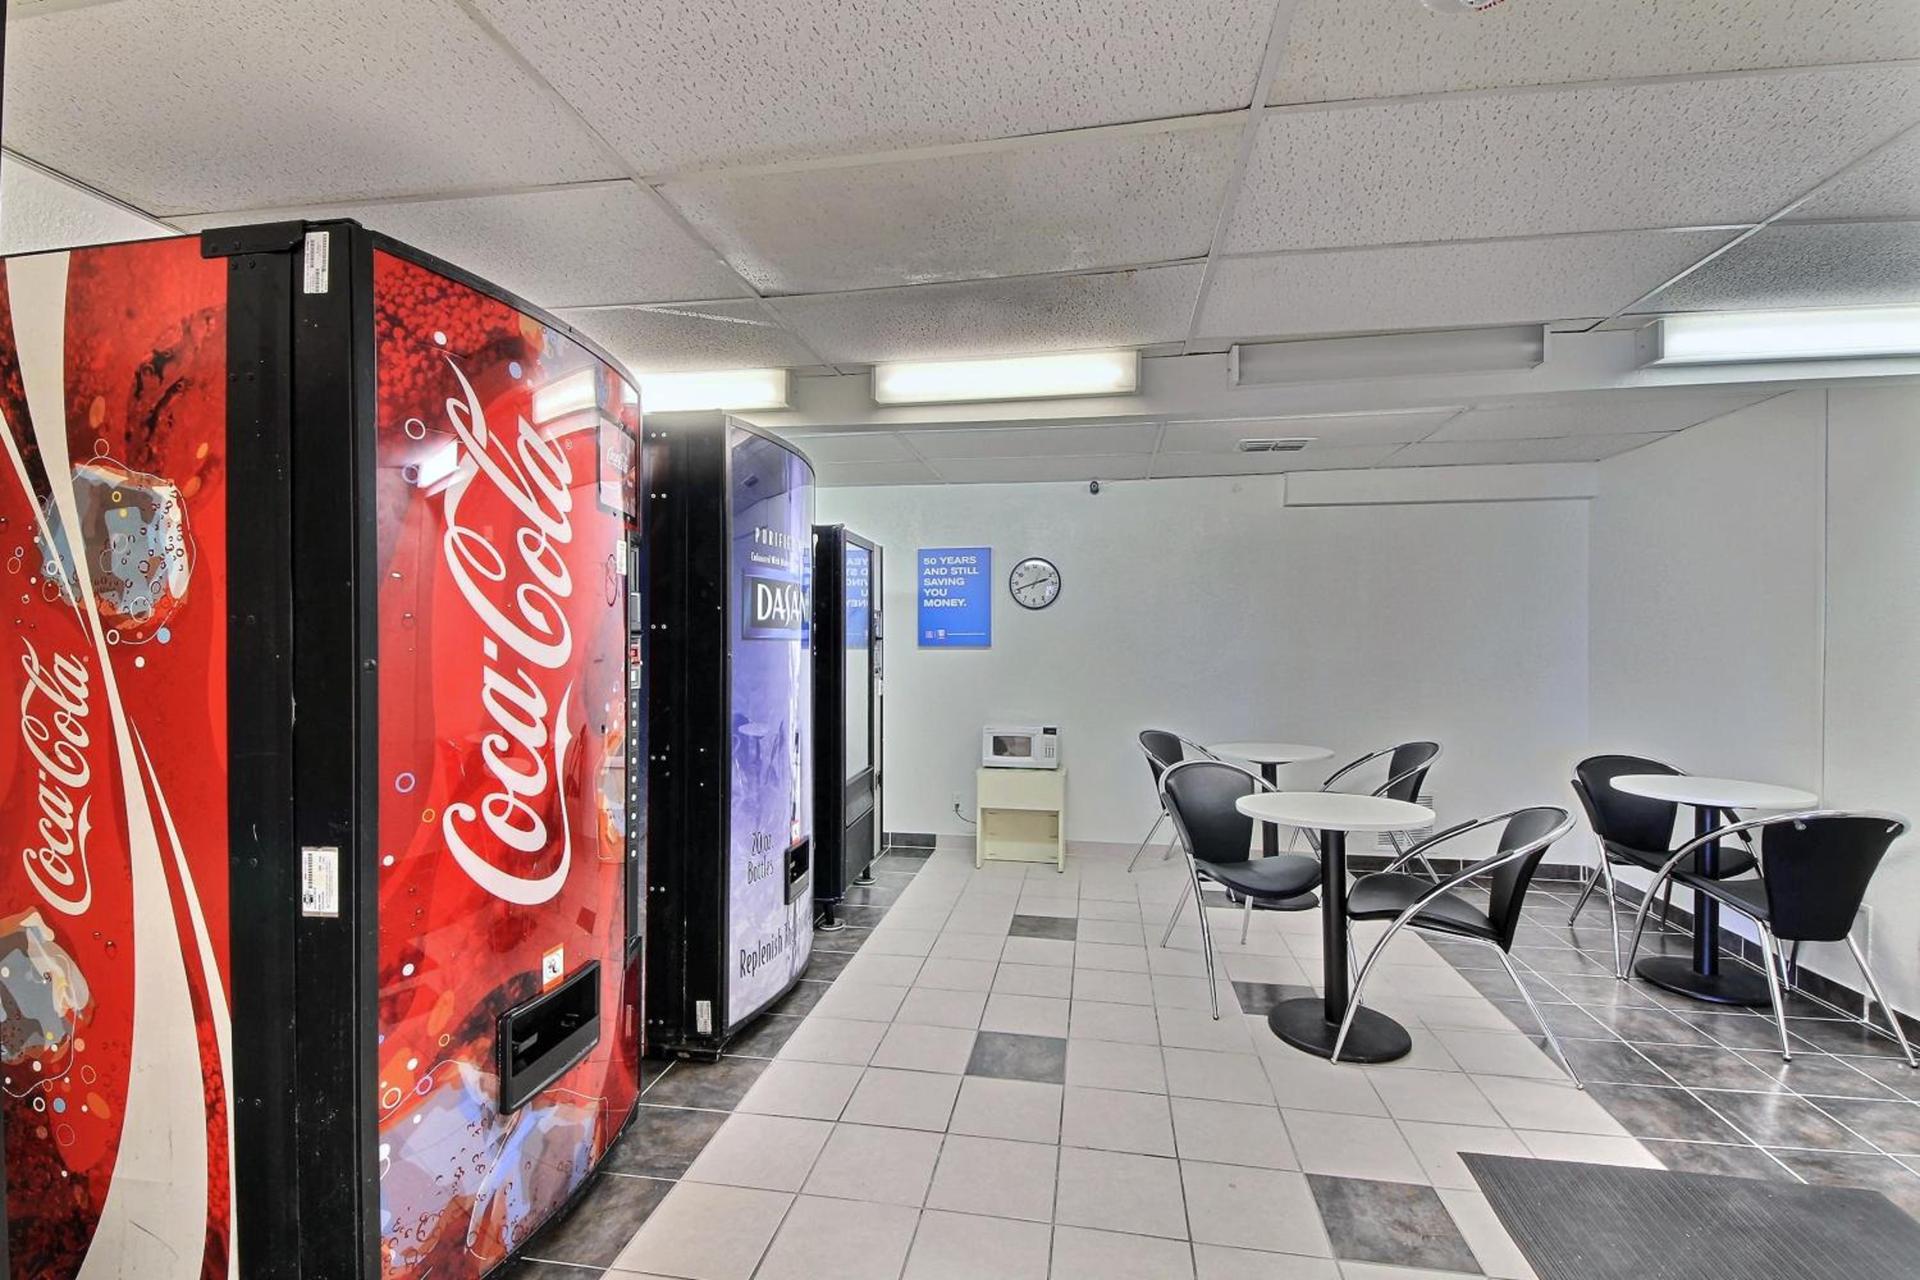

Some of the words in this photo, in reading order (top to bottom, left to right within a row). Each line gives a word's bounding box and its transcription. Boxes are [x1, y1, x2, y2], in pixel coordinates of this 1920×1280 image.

[923, 556, 937, 565] 50
[939, 555, 977, 564] YEARS
[923, 567, 948, 576] AND
[950, 566, 979, 575] STILL
[923, 577, 965, 586] SAVING
[923, 588, 948, 597] YOU
[757, 583, 807, 626] DASAN
[923, 598, 968, 608] MONEY.
[443, 356, 573, 905] Coca-Cola
[21, 635, 93, 916] Coca-Cola
[747, 855, 774, 884] Bottles
[739, 928, 783, 978] Replenish
